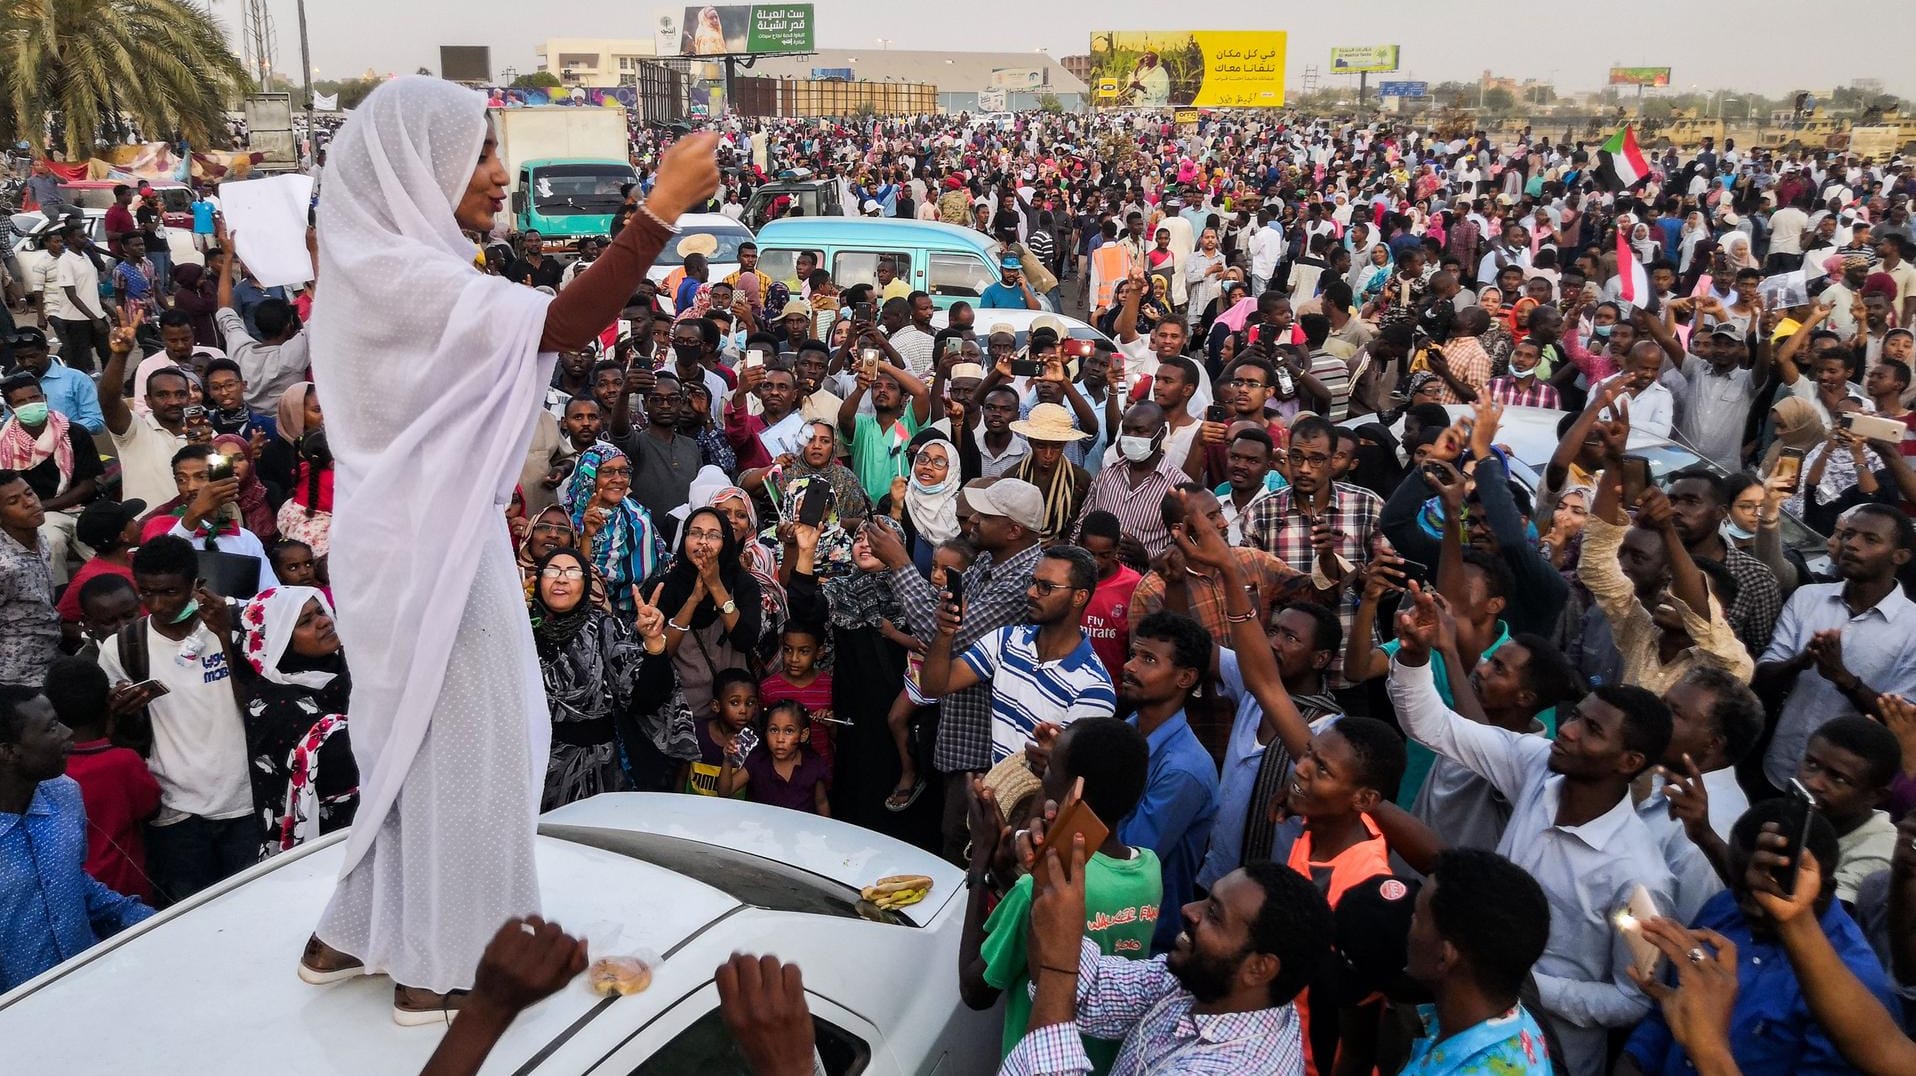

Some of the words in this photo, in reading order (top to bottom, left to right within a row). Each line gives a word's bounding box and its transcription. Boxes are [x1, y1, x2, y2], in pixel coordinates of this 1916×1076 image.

[757, 9, 785, 20] العيلة
[788, 10, 804, 18] ست
[757, 20, 787, 31] الشيلة
[789, 20, 805, 32] قدر
[1216, 49, 1241, 60] مكان
[1243, 49, 1258, 60] كل
[1260, 48, 1276, 62] في
[1215, 64, 1241, 72] معاك
[1087, 615, 1104, 627] Fly
